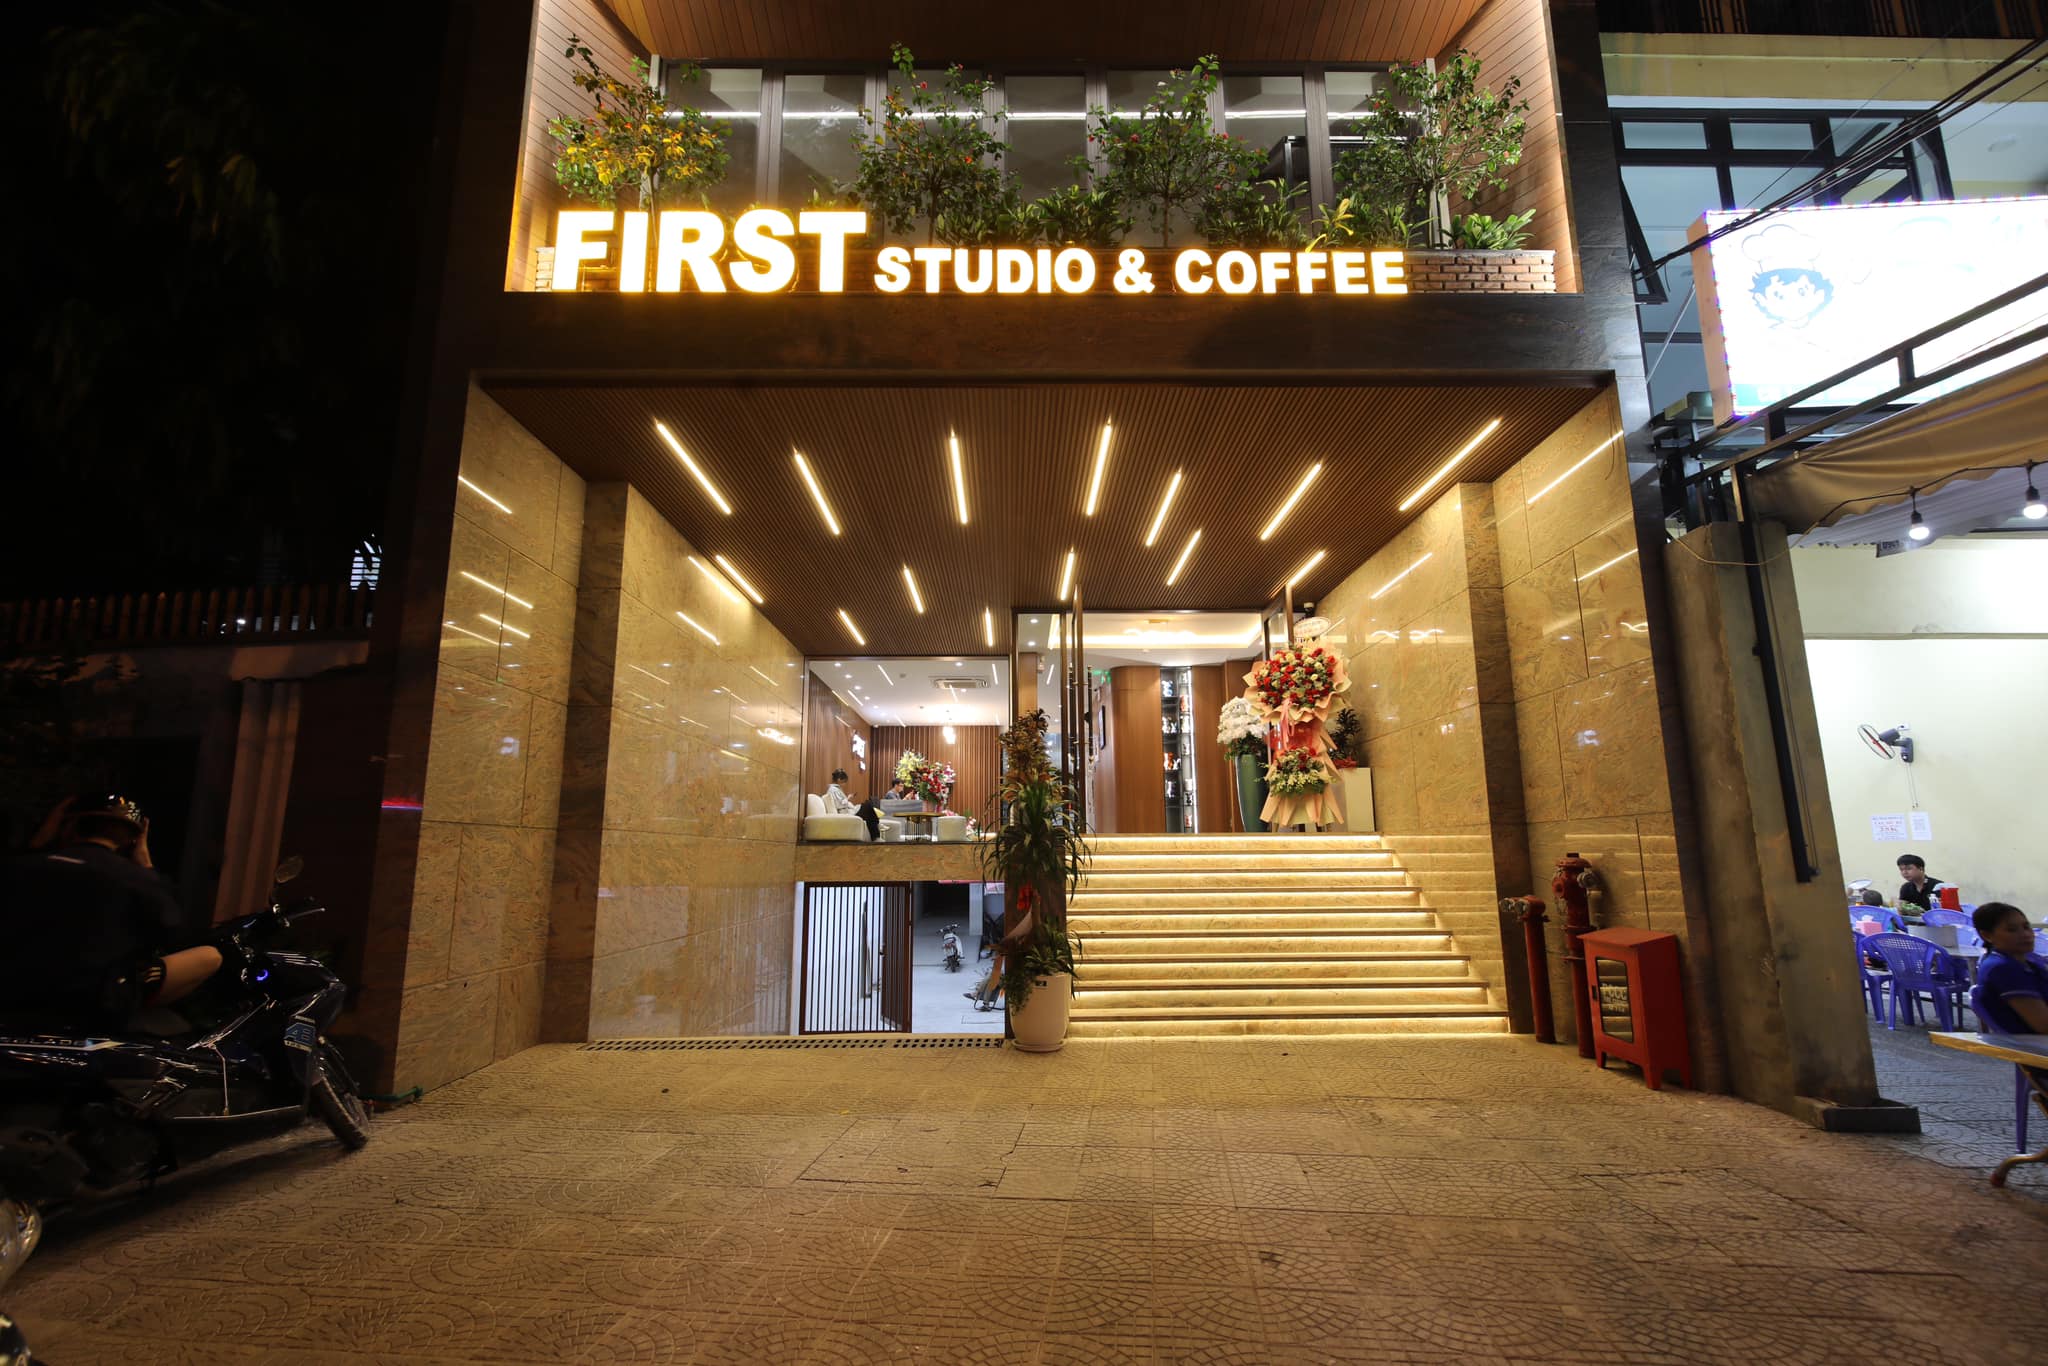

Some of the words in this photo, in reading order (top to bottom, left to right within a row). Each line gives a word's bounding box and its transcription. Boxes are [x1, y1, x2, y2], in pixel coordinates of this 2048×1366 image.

[552, 209, 868, 293] FIRST
[874, 247, 1096, 293] STUDIO
[1112, 249, 1156, 293] &
[1174, 249, 1409, 294] COFFEE
